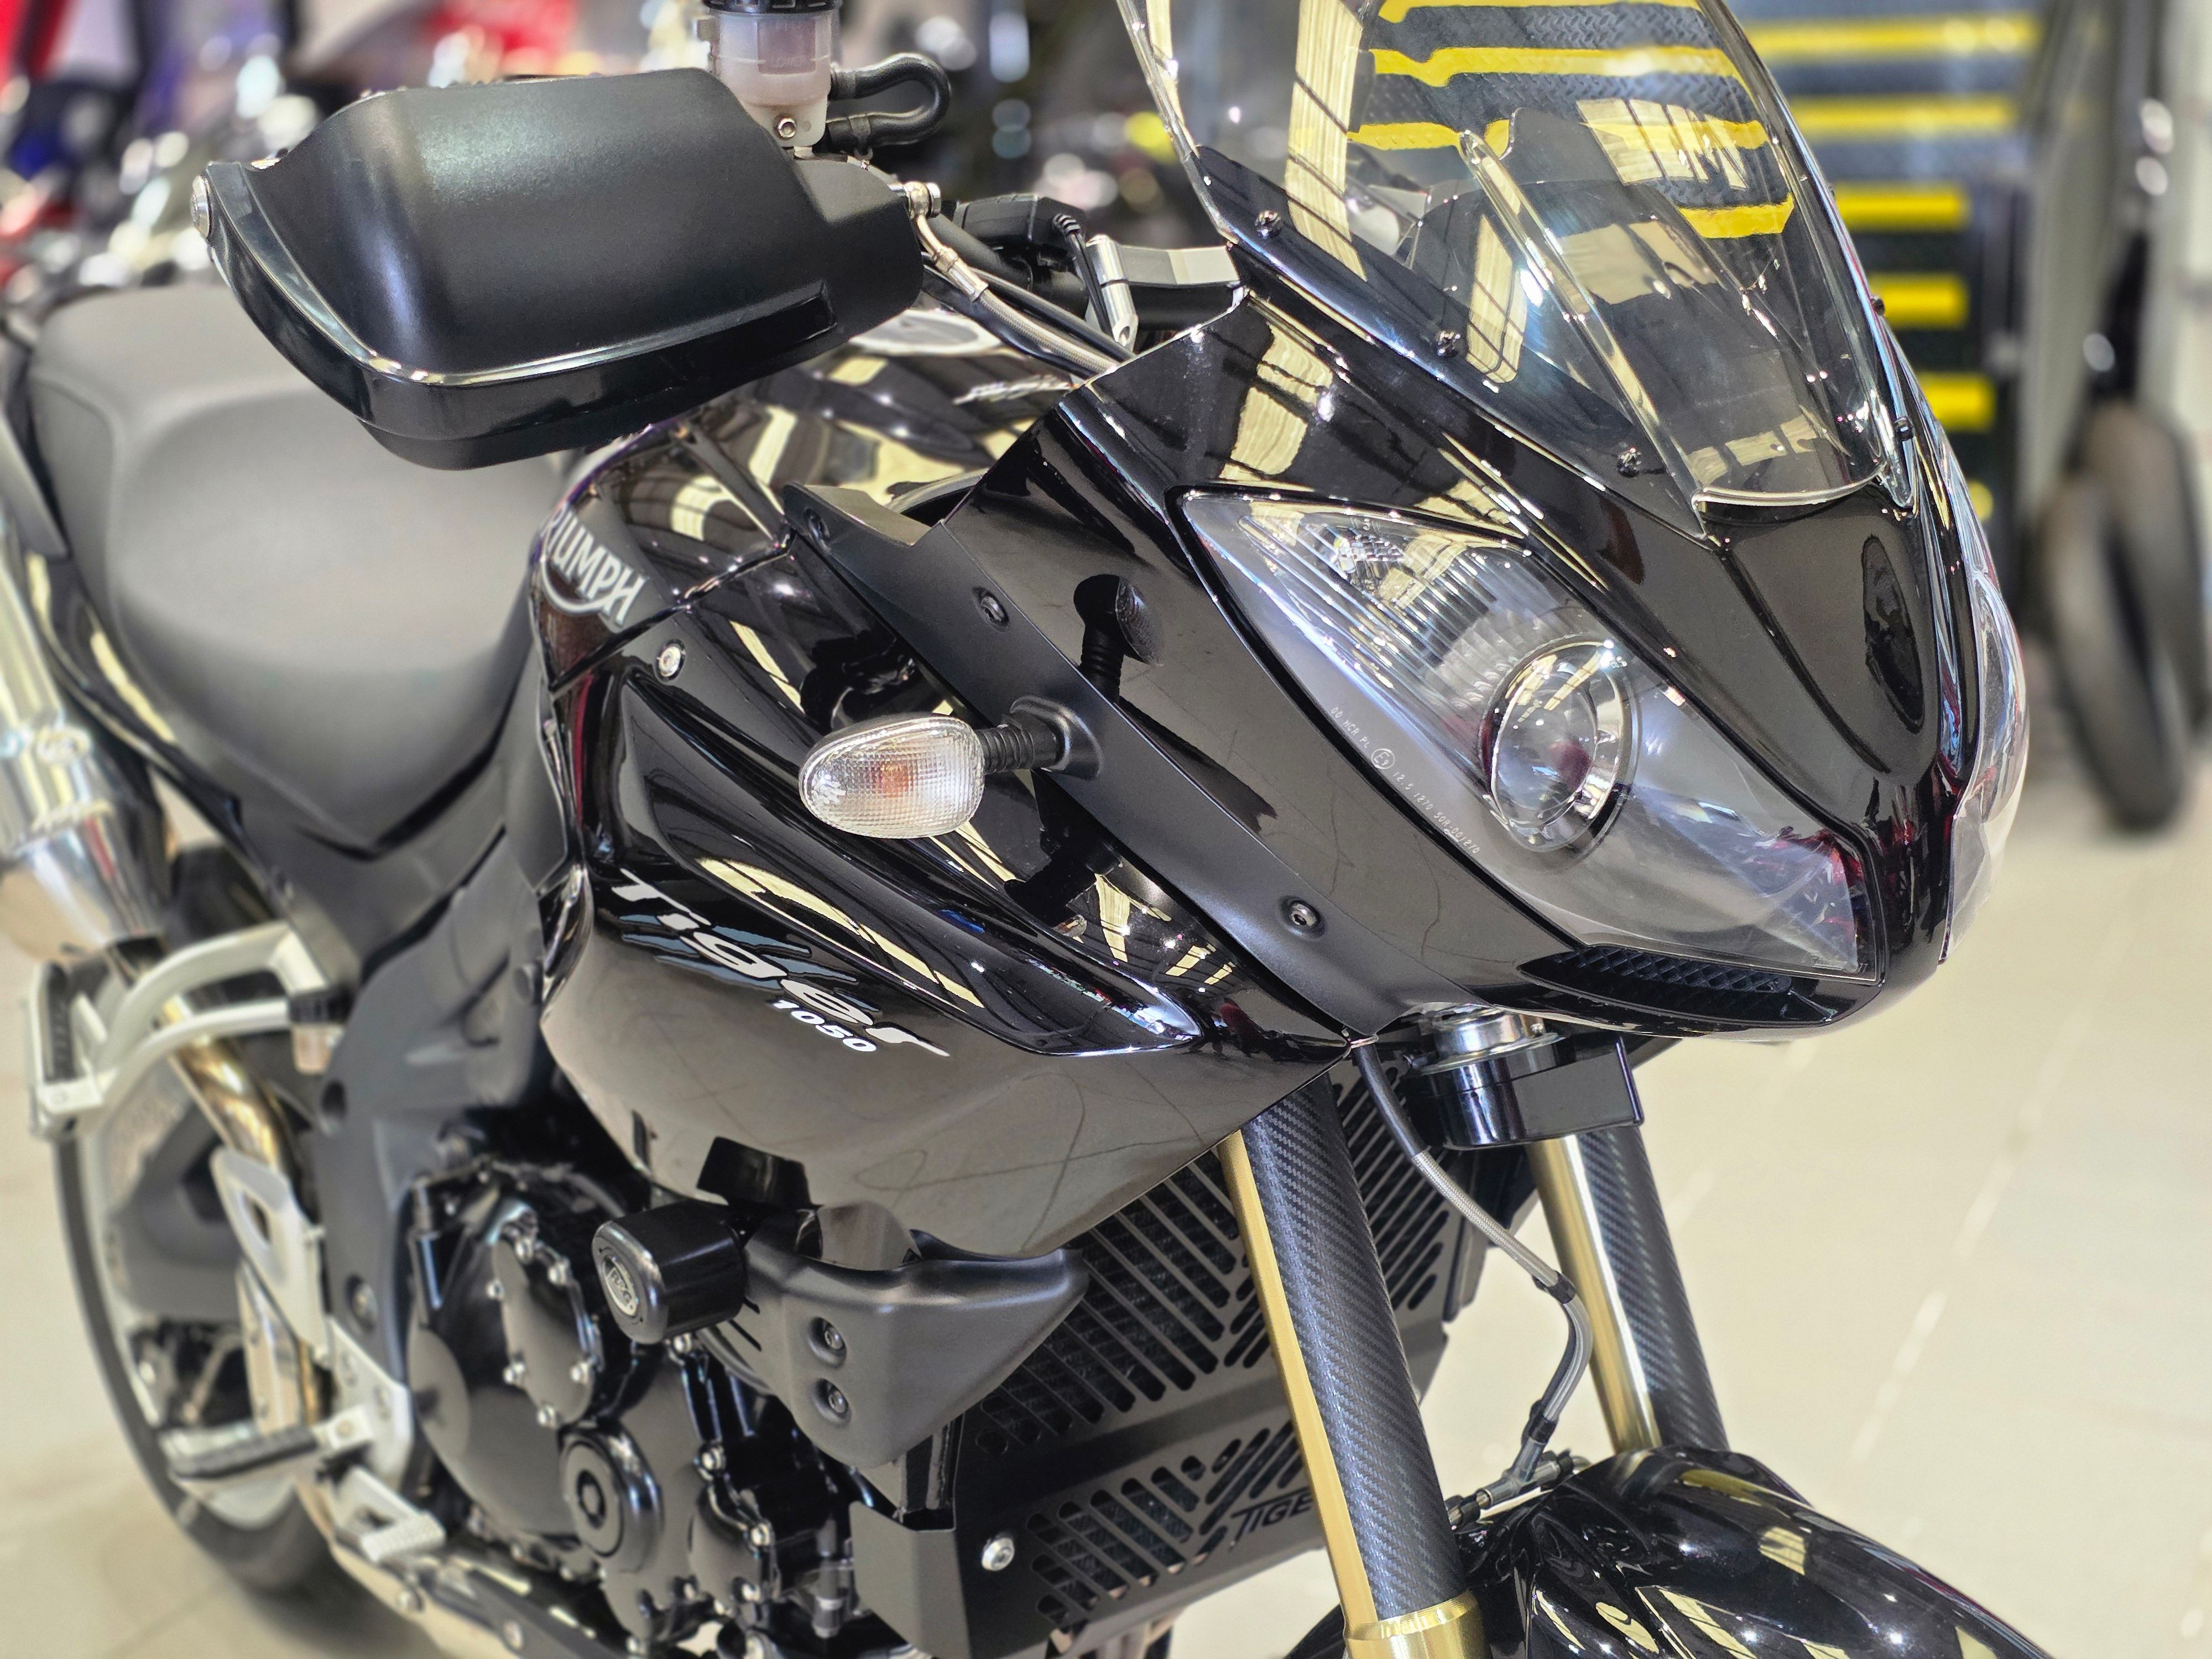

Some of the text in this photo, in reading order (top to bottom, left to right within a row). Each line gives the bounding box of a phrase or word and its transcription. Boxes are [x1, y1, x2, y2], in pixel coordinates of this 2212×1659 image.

[1343, 720, 1359, 737] HCR
[1413, 792, 1433, 811] 1270
[773, 998, 878, 1052] 1050
[1229, 1485, 1314, 1551] TIGE
